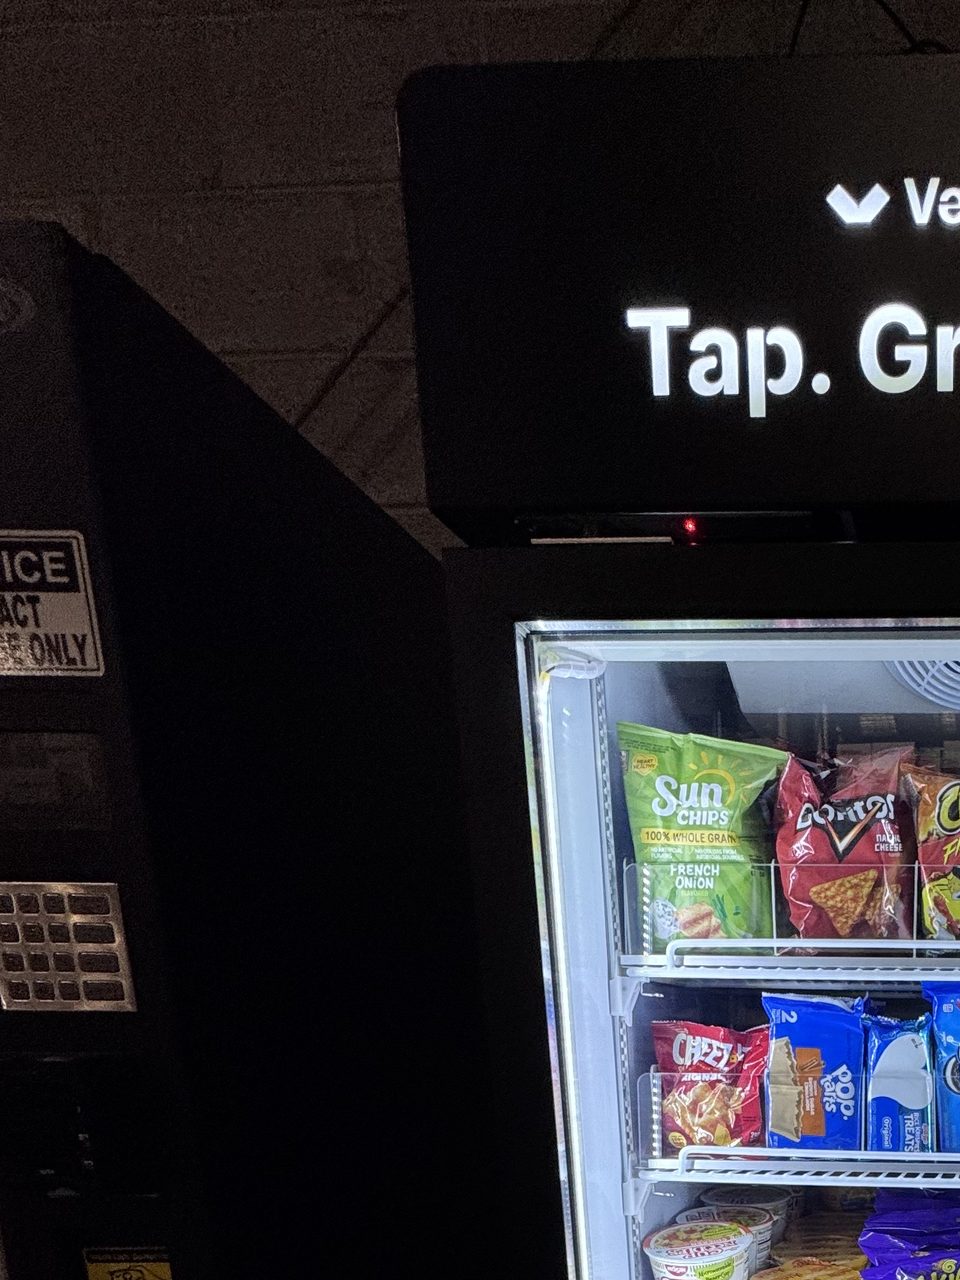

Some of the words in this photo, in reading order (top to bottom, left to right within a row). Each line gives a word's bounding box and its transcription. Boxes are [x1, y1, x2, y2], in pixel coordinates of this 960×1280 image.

[626, 307, 831, 419] Tap.
[29, 633, 87, 666] ONLY
[652, 775, 722, 817] Sun
[677, 810, 729, 825] CHIPS
[645, 831, 670, 841] 100%
[673, 832, 705, 843] WHOLE
[875, 844, 903, 852] CHEESE
[670, 864, 720, 876] FRENCH
[883, 1117, 892, 1148] Original
[904, 1114, 914, 1152] TREATS
